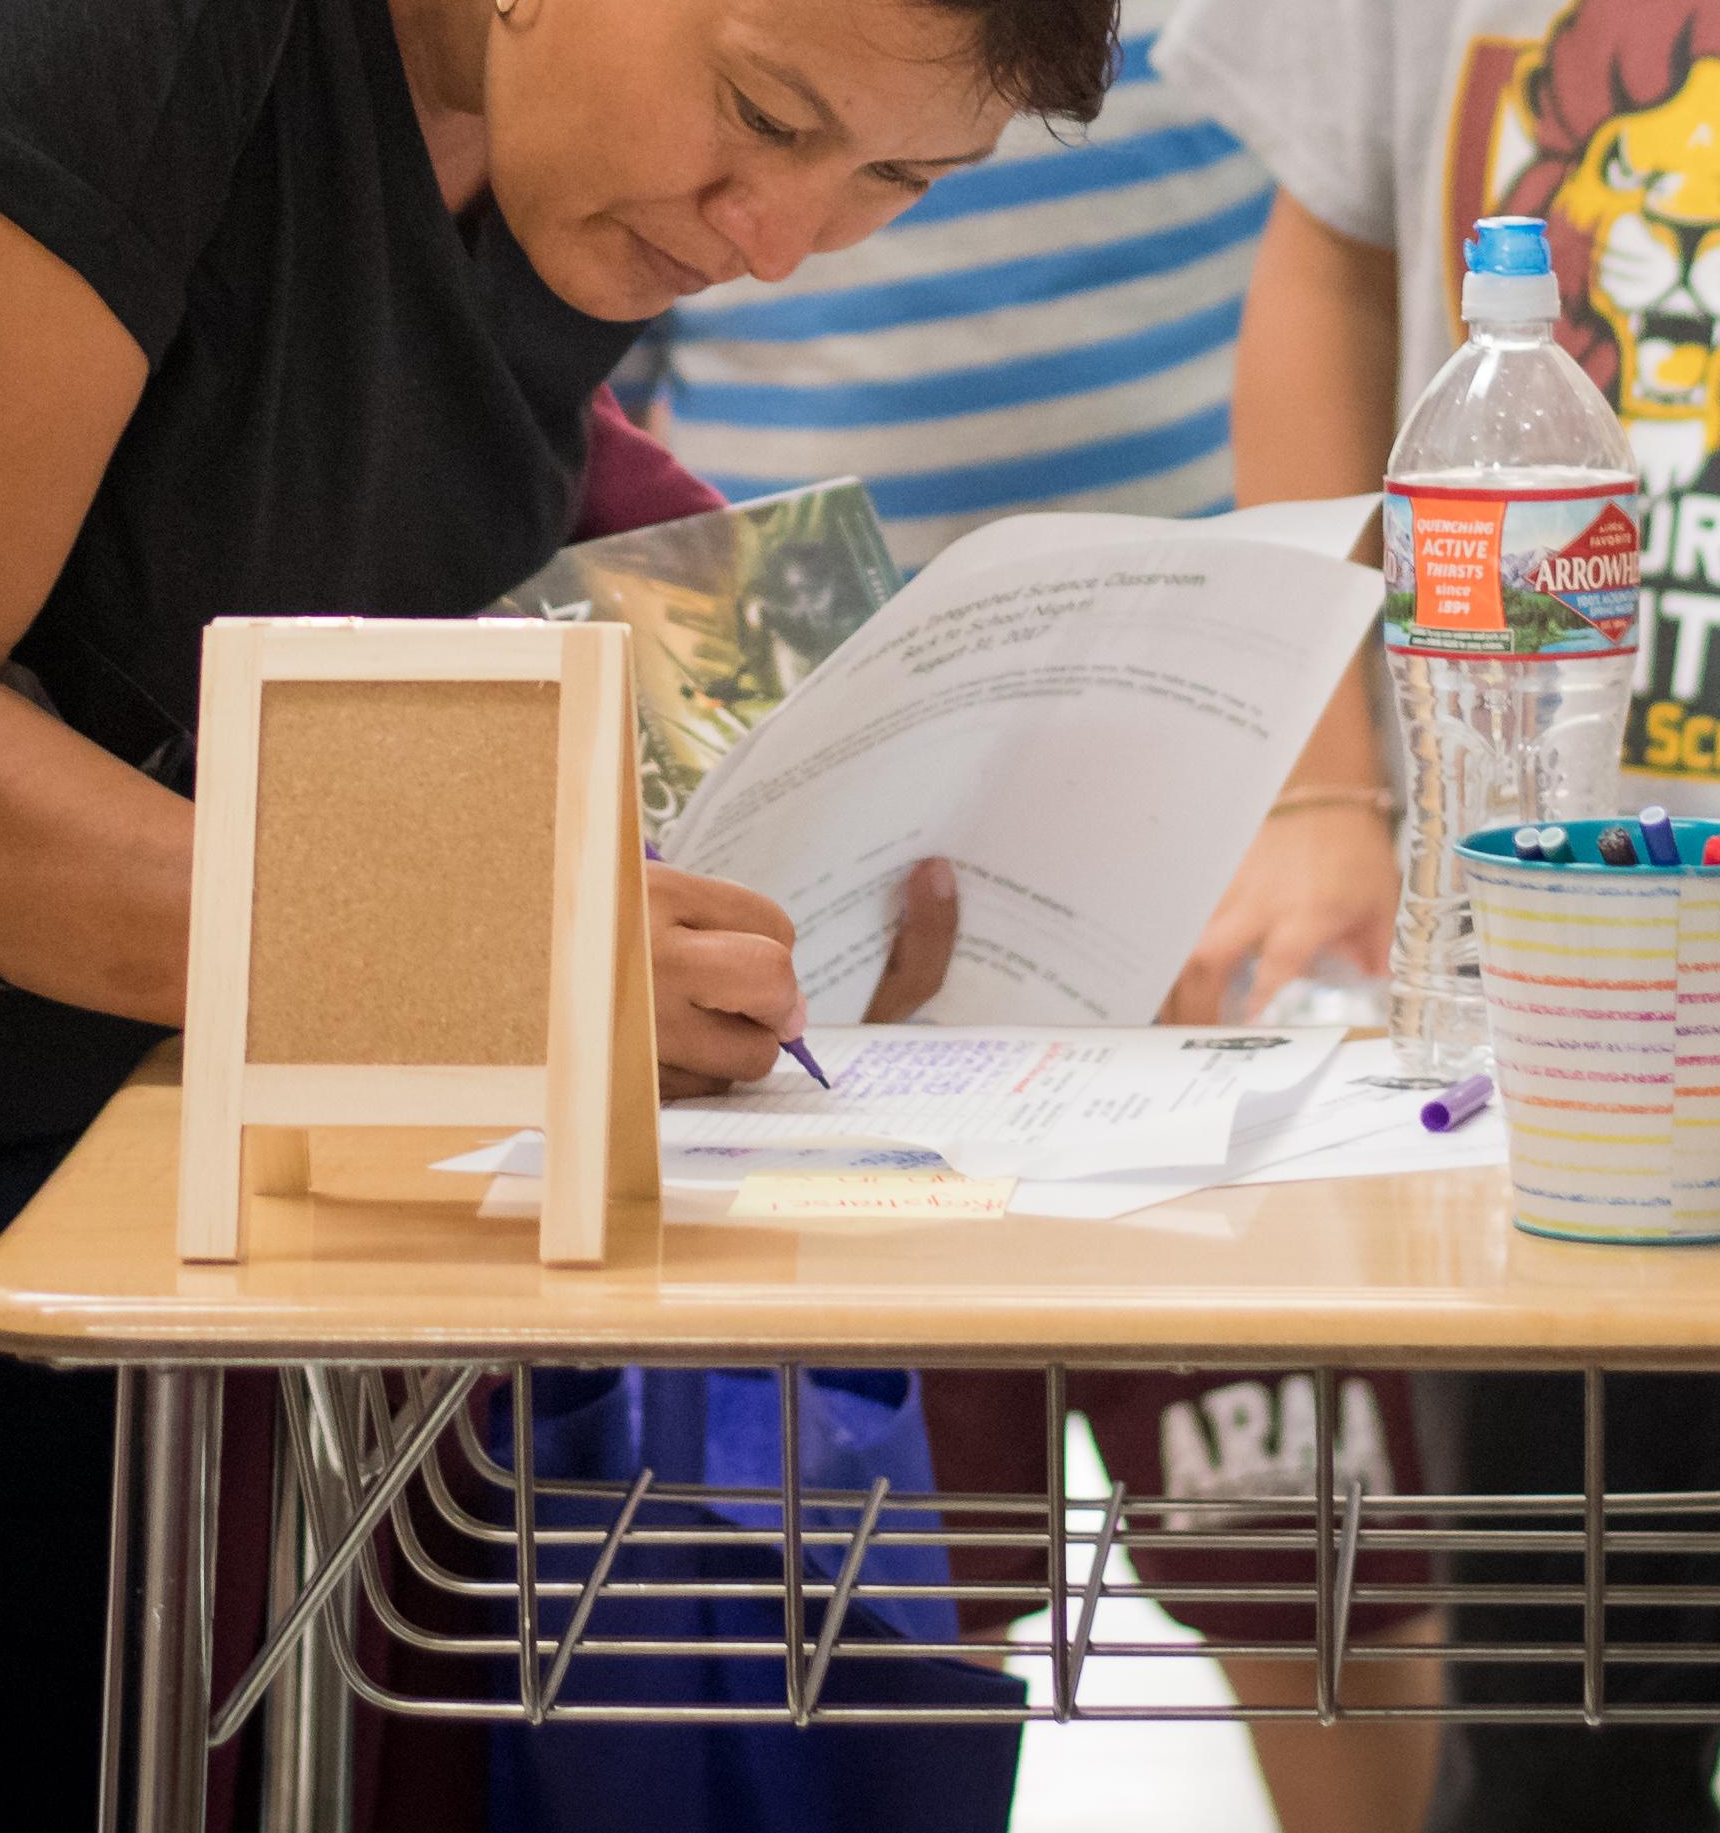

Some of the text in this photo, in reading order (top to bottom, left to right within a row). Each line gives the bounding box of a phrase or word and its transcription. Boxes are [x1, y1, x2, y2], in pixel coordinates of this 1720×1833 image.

[1417, 518, 1495, 535] QUENCHING
[1422, 538, 1488, 559] ACTIVE
[1426, 562, 1484, 580] THIRSTS
[1435, 583, 1472, 597] since
[1437, 600, 1471, 615] 1894
